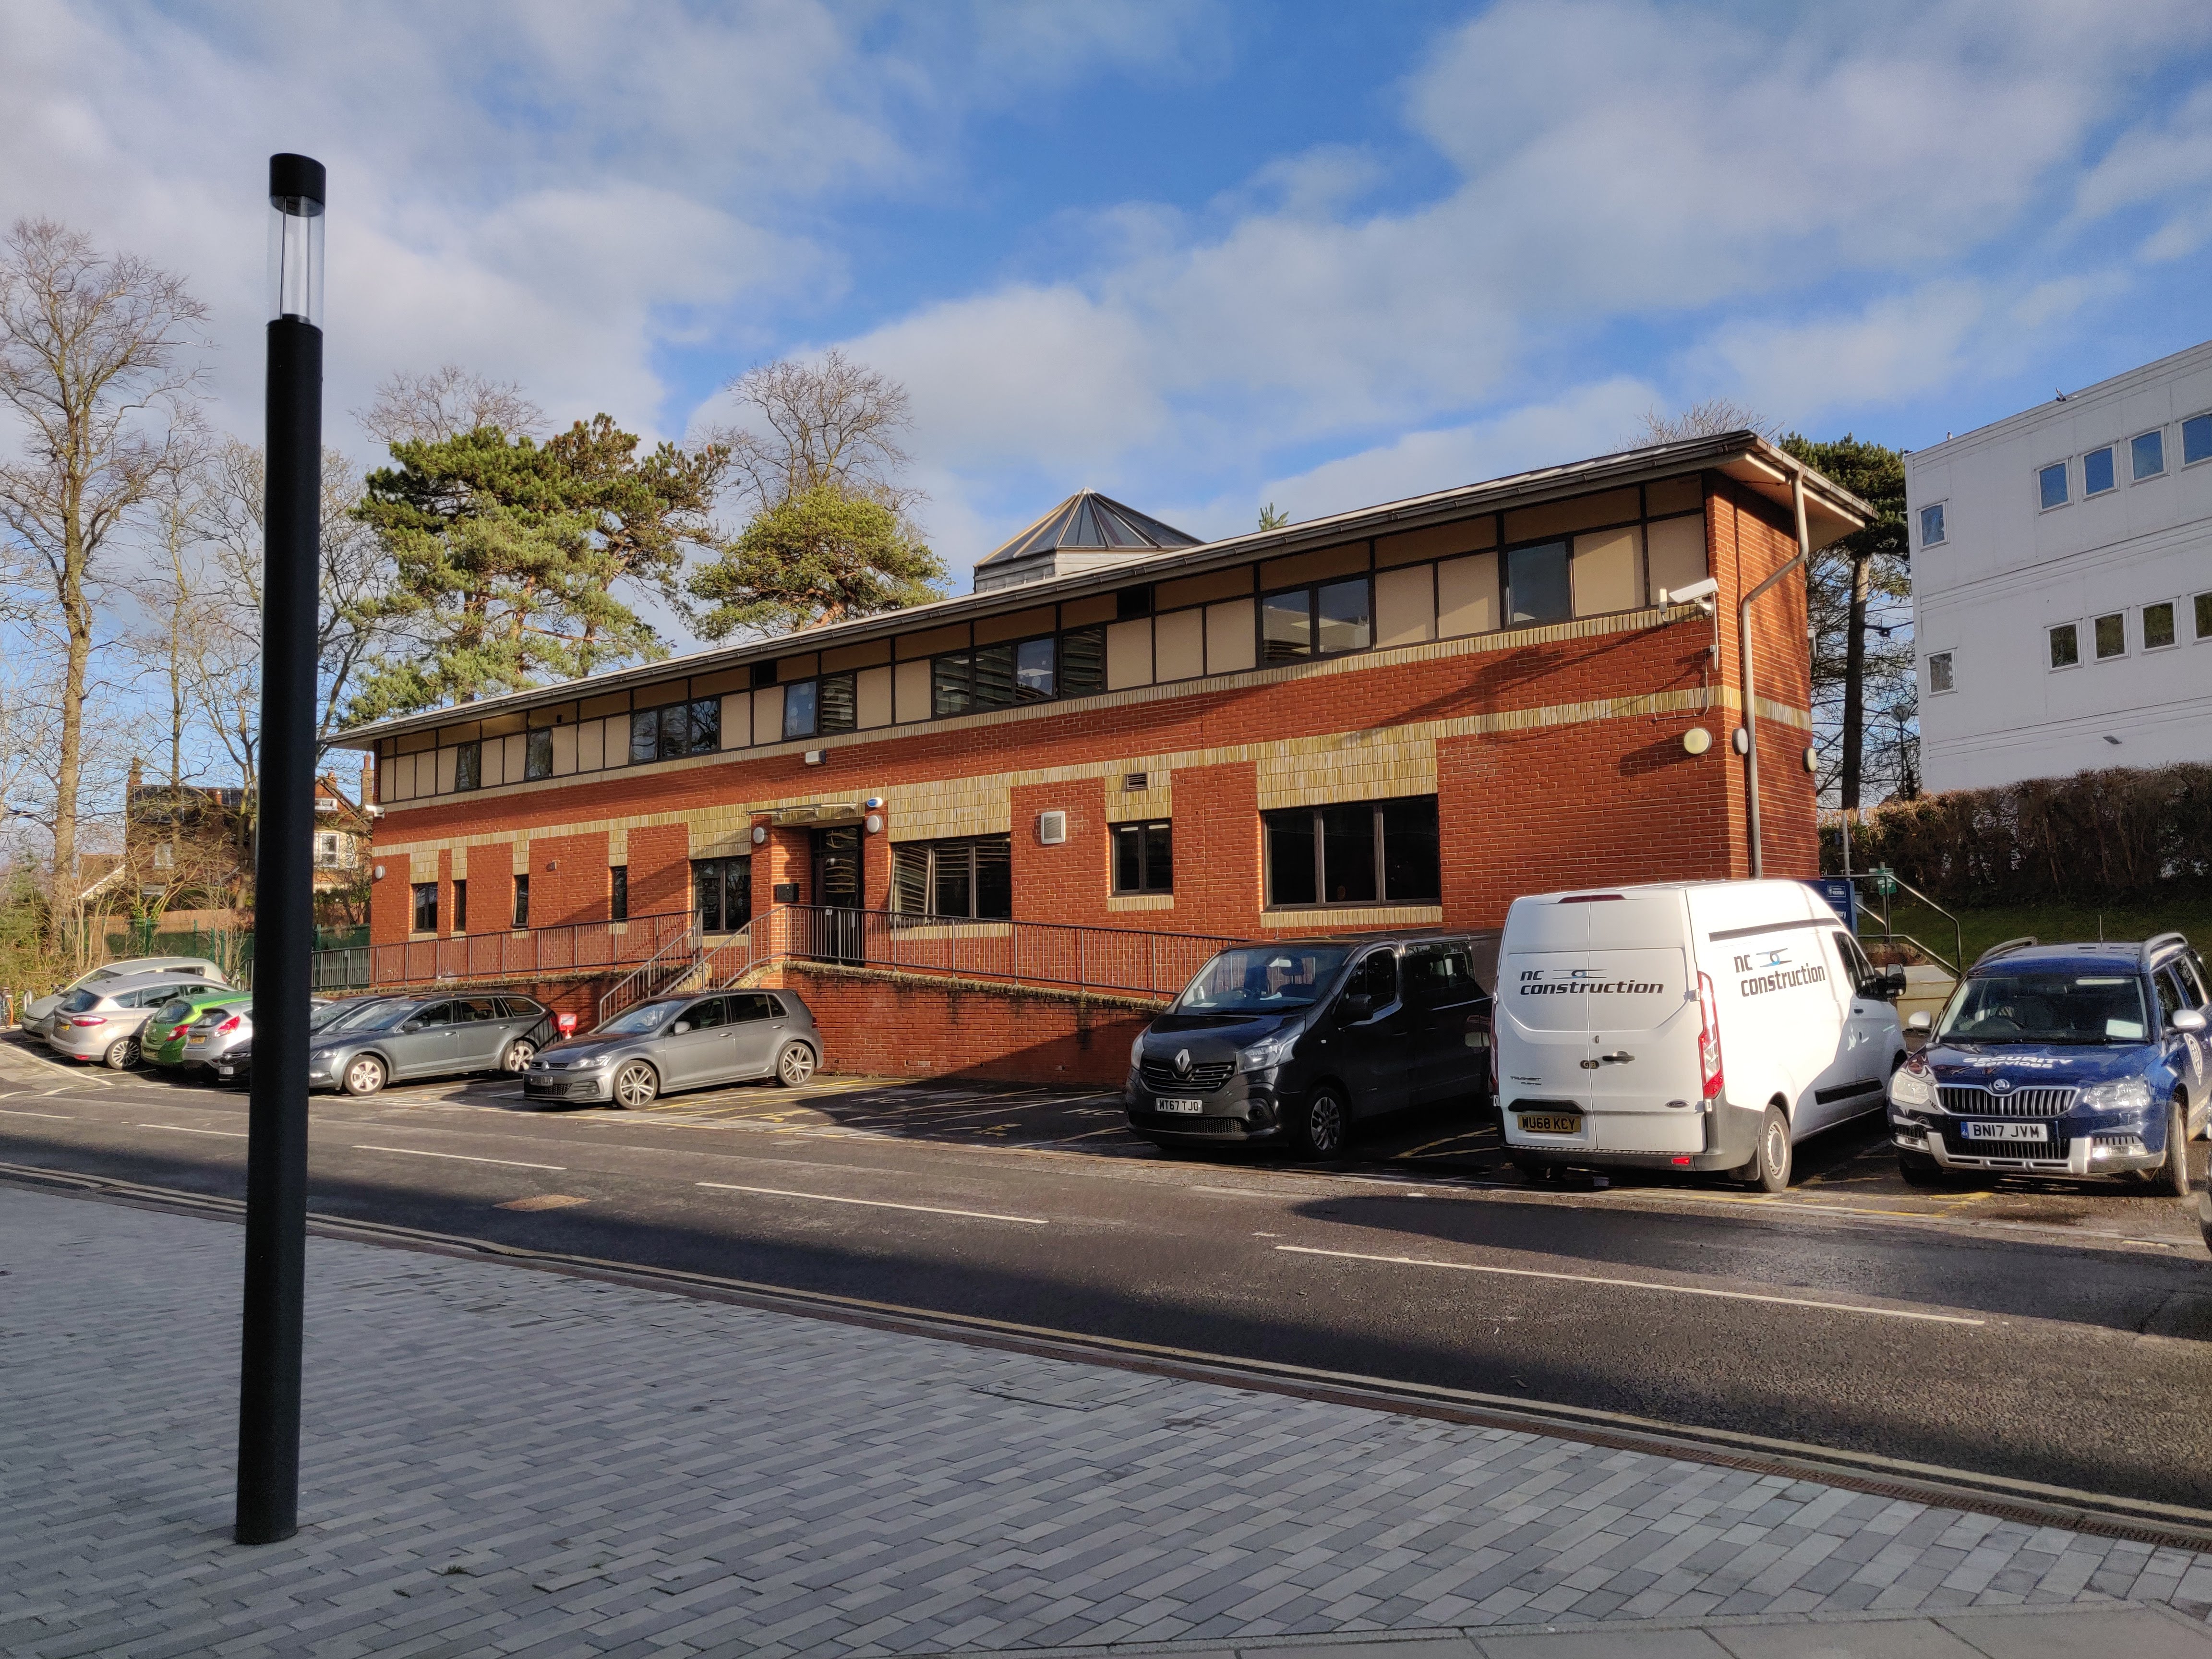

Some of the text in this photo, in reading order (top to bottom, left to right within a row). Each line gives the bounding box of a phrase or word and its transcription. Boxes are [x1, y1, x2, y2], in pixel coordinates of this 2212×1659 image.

[1733, 954, 1753, 973] nc
[1520, 970, 1544, 981] nc
[1741, 962, 1826, 997] construction
[1520, 979, 1664, 995] construction
[1159, 1099, 1179, 1110] MT67
[1522, 1117, 1575, 1130] WU68 KCY
[1973, 1124, 2040, 1138] BN17 JVM
